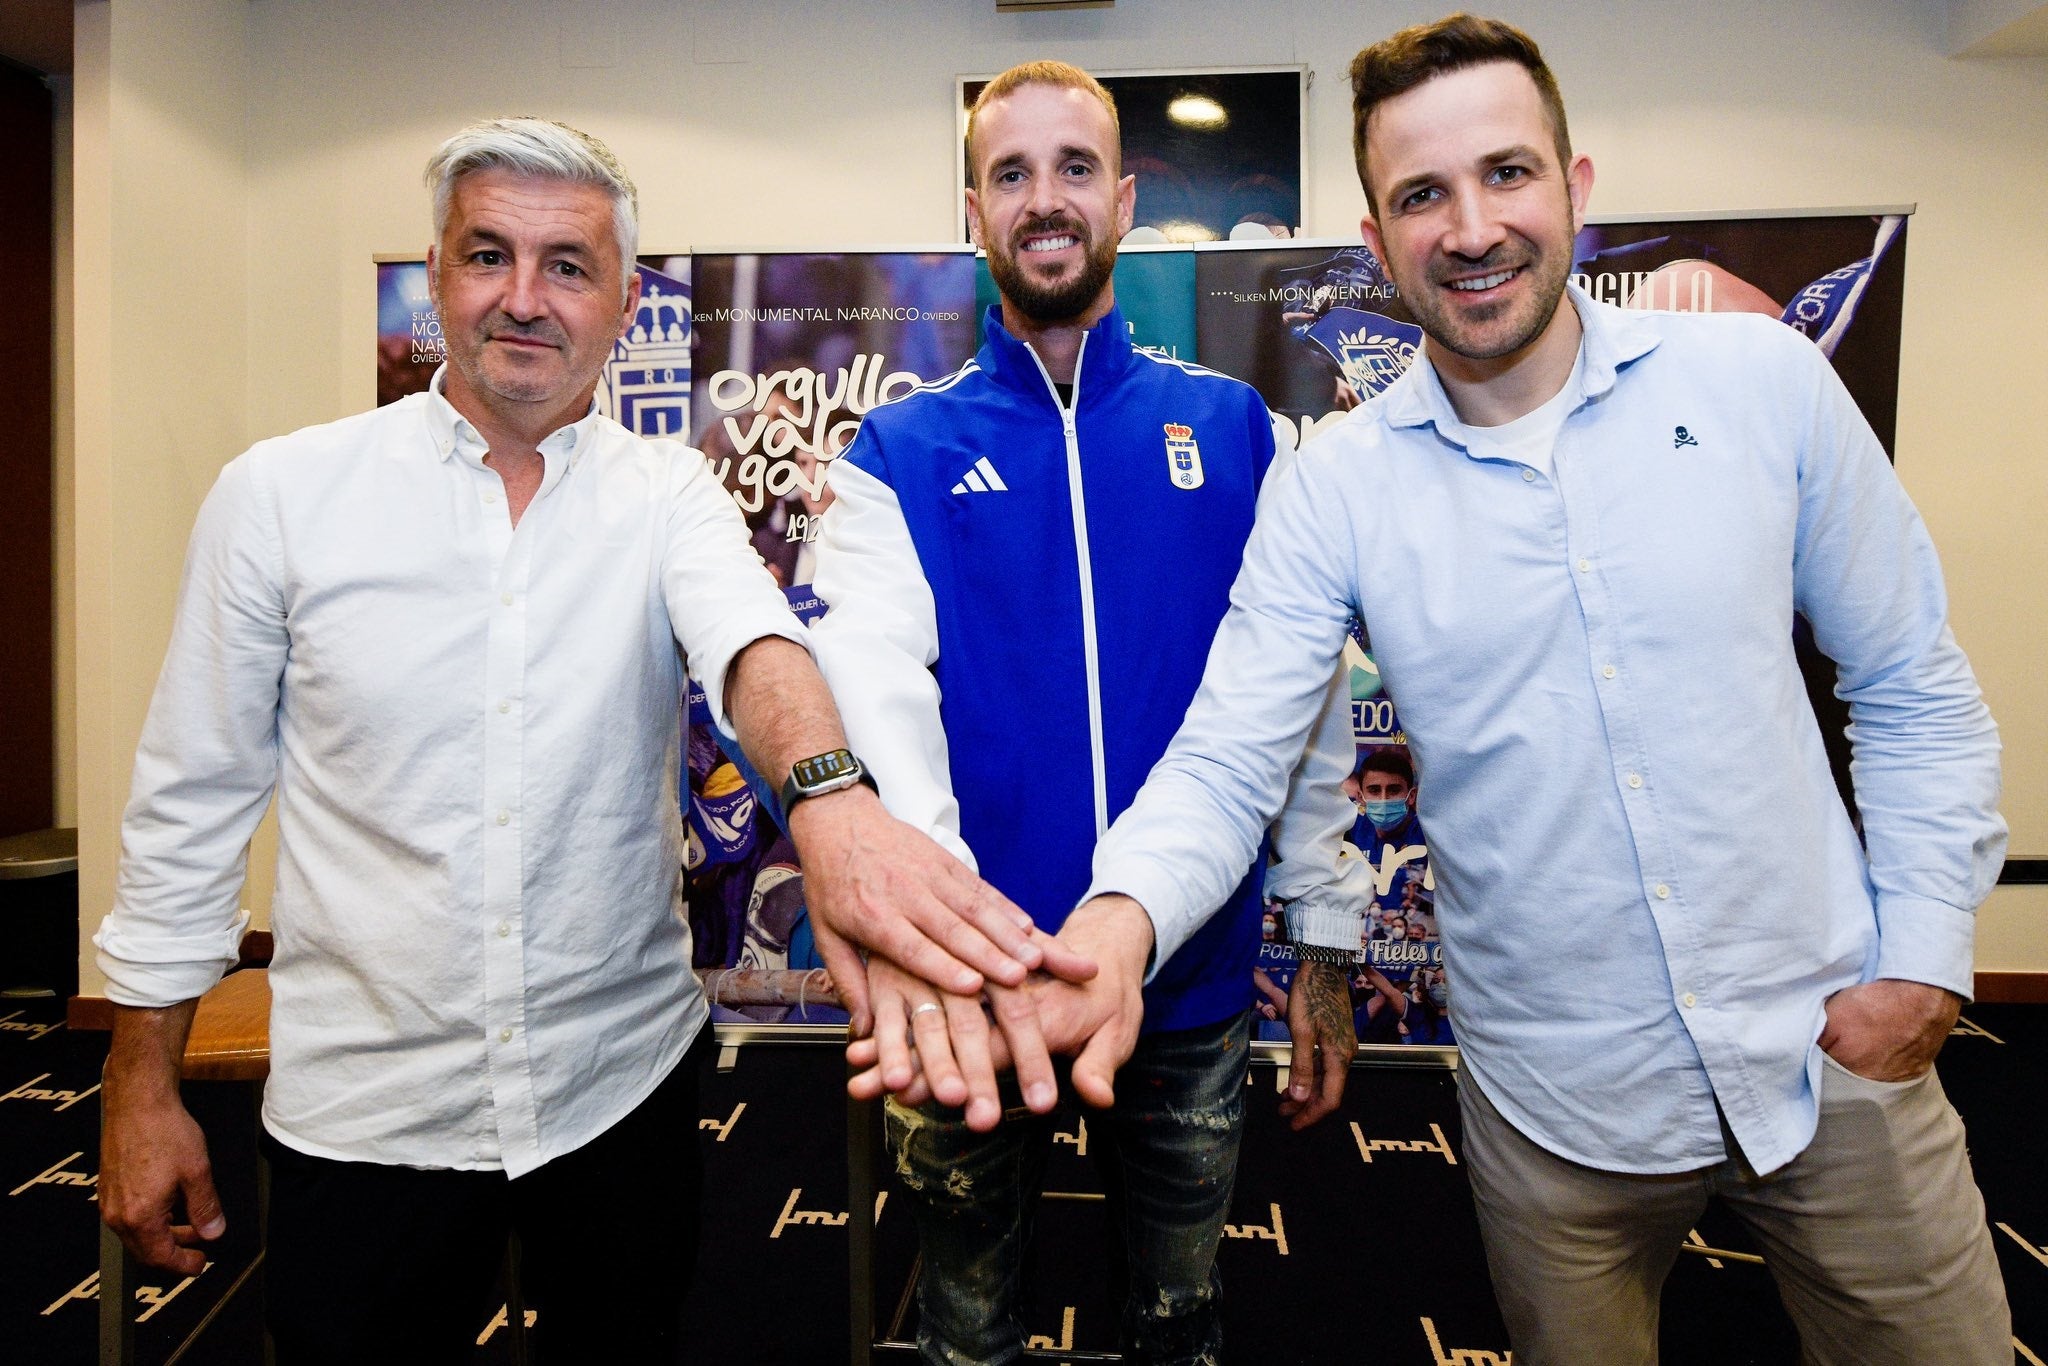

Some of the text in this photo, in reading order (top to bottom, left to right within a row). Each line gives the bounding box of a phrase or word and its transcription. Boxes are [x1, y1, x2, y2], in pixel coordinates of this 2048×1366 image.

[1234, 293, 1267, 303] SILKEN
[412, 311, 440, 321] SILKE
[691, 307, 959, 322] KEN MONUMENTAL NARANCO OVIEDO
[411, 353, 448, 364] OVIEDO
[1370, 938, 1428, 963] Fieles
